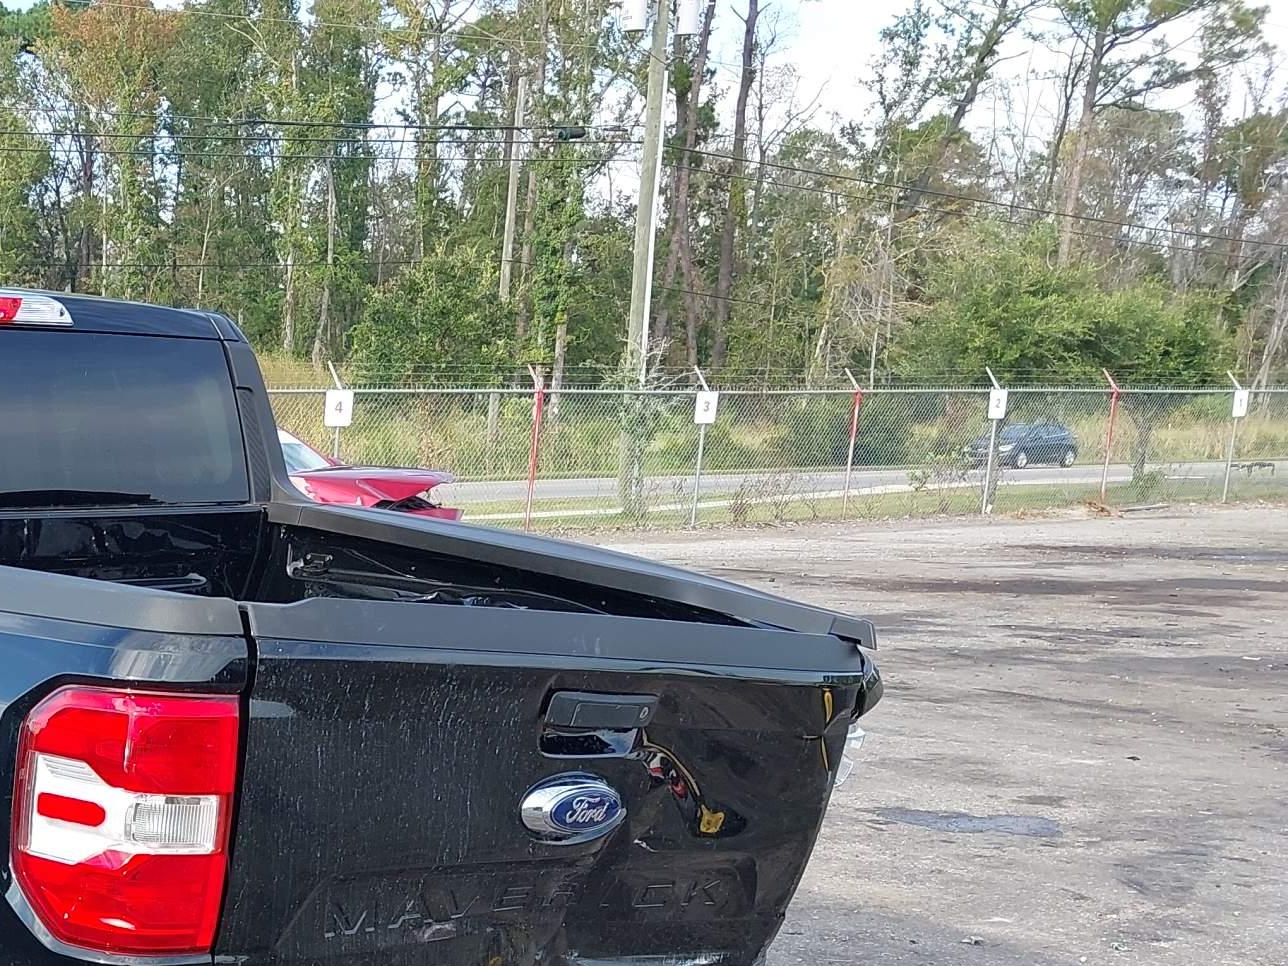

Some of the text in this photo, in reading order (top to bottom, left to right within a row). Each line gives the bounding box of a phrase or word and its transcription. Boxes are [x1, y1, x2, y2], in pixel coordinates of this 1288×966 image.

[334, 400, 344, 414] 4
[703, 400, 711, 412] 3
[995, 398, 1001, 409] 2
[565, 796, 610, 824] Ford
[323, 879, 722, 938] MAVERCK
